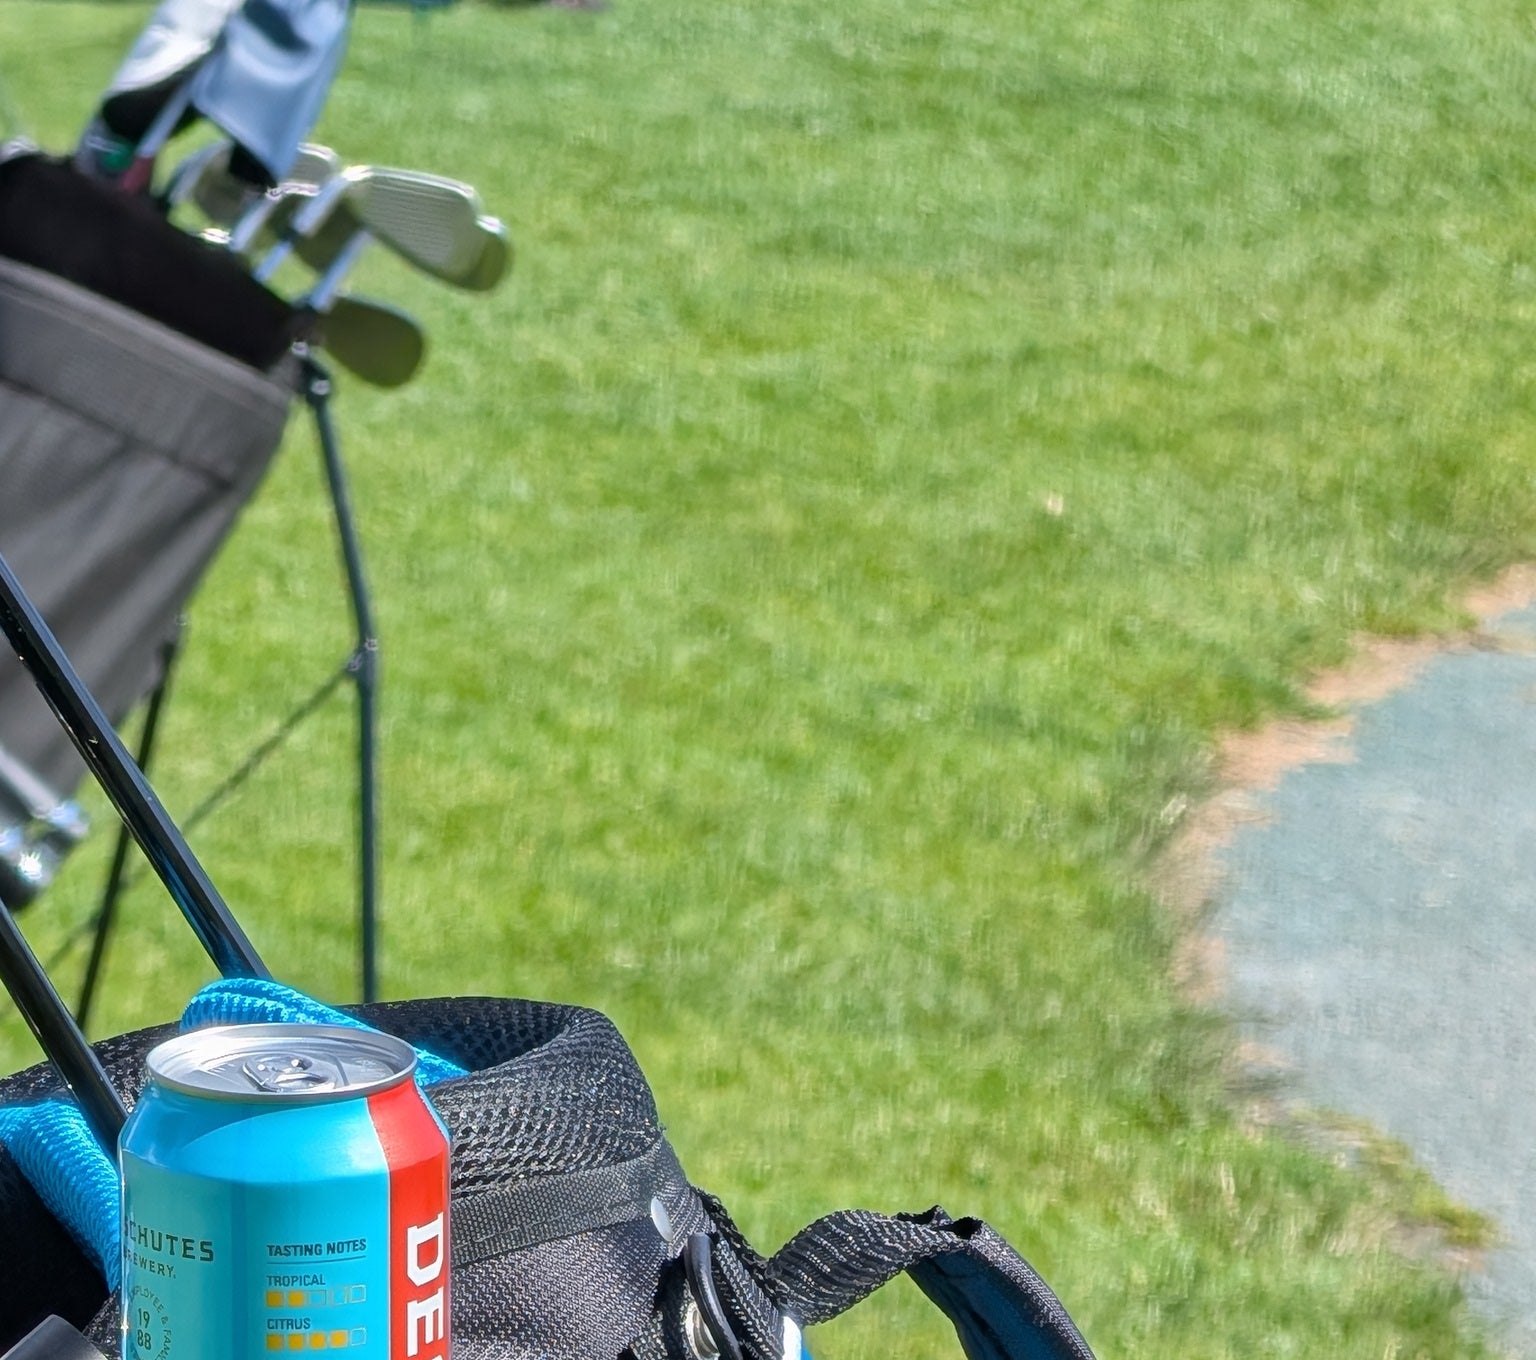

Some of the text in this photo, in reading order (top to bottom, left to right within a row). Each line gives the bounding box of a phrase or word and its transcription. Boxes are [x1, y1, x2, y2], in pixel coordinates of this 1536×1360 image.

[266, 1238, 366, 1257] TASTING NOTES
[266, 1274, 326, 1287] TROPICAL
[137, 1308, 151, 1329] 19
[267, 1318, 311, 1330] CITRUS
